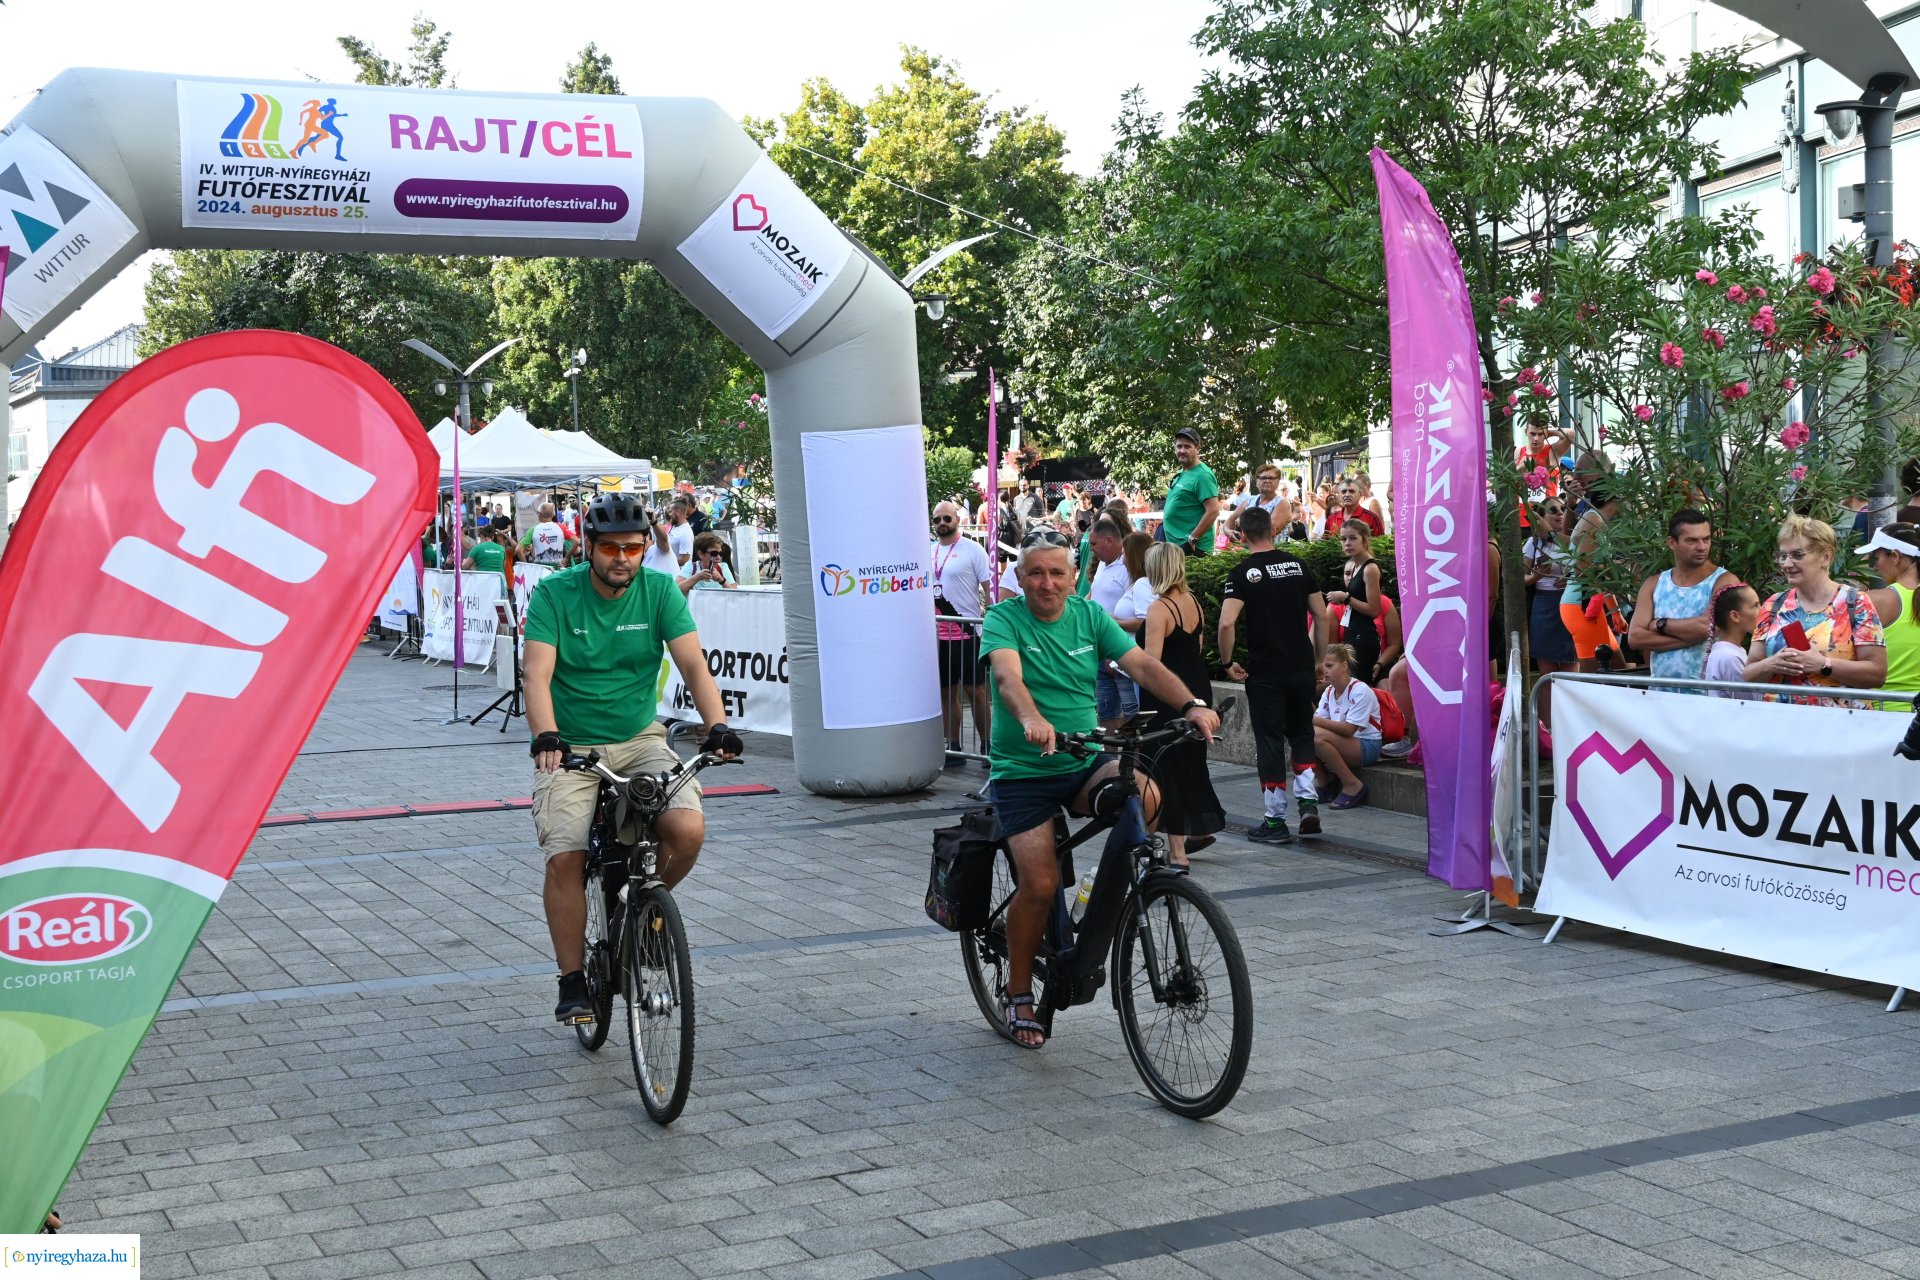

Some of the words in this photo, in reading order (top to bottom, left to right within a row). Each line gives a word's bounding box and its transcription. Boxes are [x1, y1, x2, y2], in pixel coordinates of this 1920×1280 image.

[389, 113, 632, 158] RAJT/CÉL
[226, 144, 234, 155] 1
[249, 145, 260, 156] 2
[270, 146, 281, 157] 3
[200, 163, 217, 176] IV.
[222, 165, 371, 182] WITTUR-NYÍREGYHÁZI
[198, 178, 371, 203] FUTÓFESZTIVÁL
[198, 200, 246, 214] 2024.
[251, 204, 338, 218] augusztus
[343, 206, 368, 218] 25.
[406, 193, 617, 211] www.nyiregyhazifutofesztival.hu
[34, 233, 91, 284] WITTUR
[761, 224, 823, 284] MOZAIK
[749, 241, 758, 250] Az
[757, 248, 775, 265] orvosi
[773, 263, 807, 297] futóközösség
[796, 272, 816, 291] med
[858, 561, 919, 576] NYÍREGYHÁZA
[1265, 561, 1298, 571] EXTREME
[1268, 568, 1288, 577] TRAIL
[859, 575, 915, 595] Többet
[27, 388, 377, 833] Alfi
[1679, 774, 1920, 861] MOZAIK
[1674, 864, 1693, 880] Az
[1697, 869, 1741, 889] orvosi
[1745, 874, 1847, 911] futóközösség
[3, 969, 83, 990] CSOPORT
[88, 965, 137, 982] TAGJA
